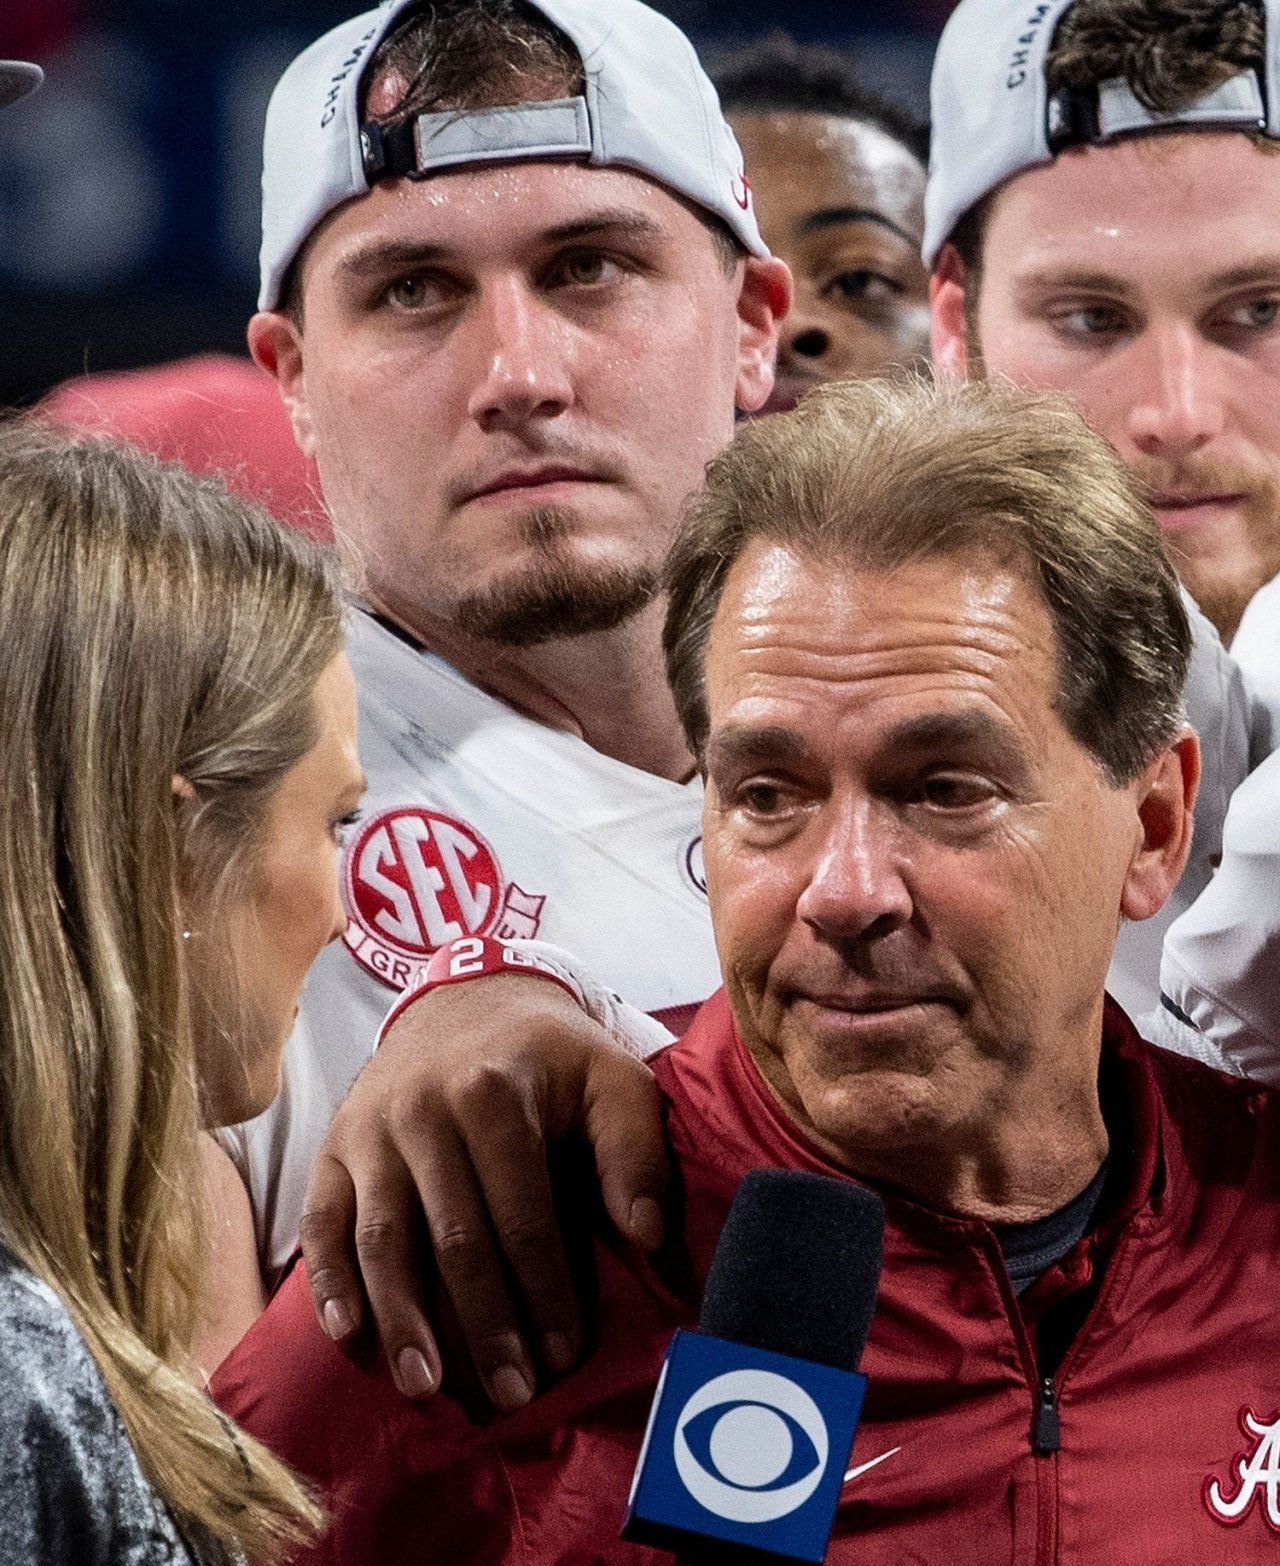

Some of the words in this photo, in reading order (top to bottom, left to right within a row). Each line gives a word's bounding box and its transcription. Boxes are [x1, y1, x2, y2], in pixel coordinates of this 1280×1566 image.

[321, 28, 376, 128] CHAMP
[357, 815, 492, 947] SEC
[450, 937, 484, 977] 2
